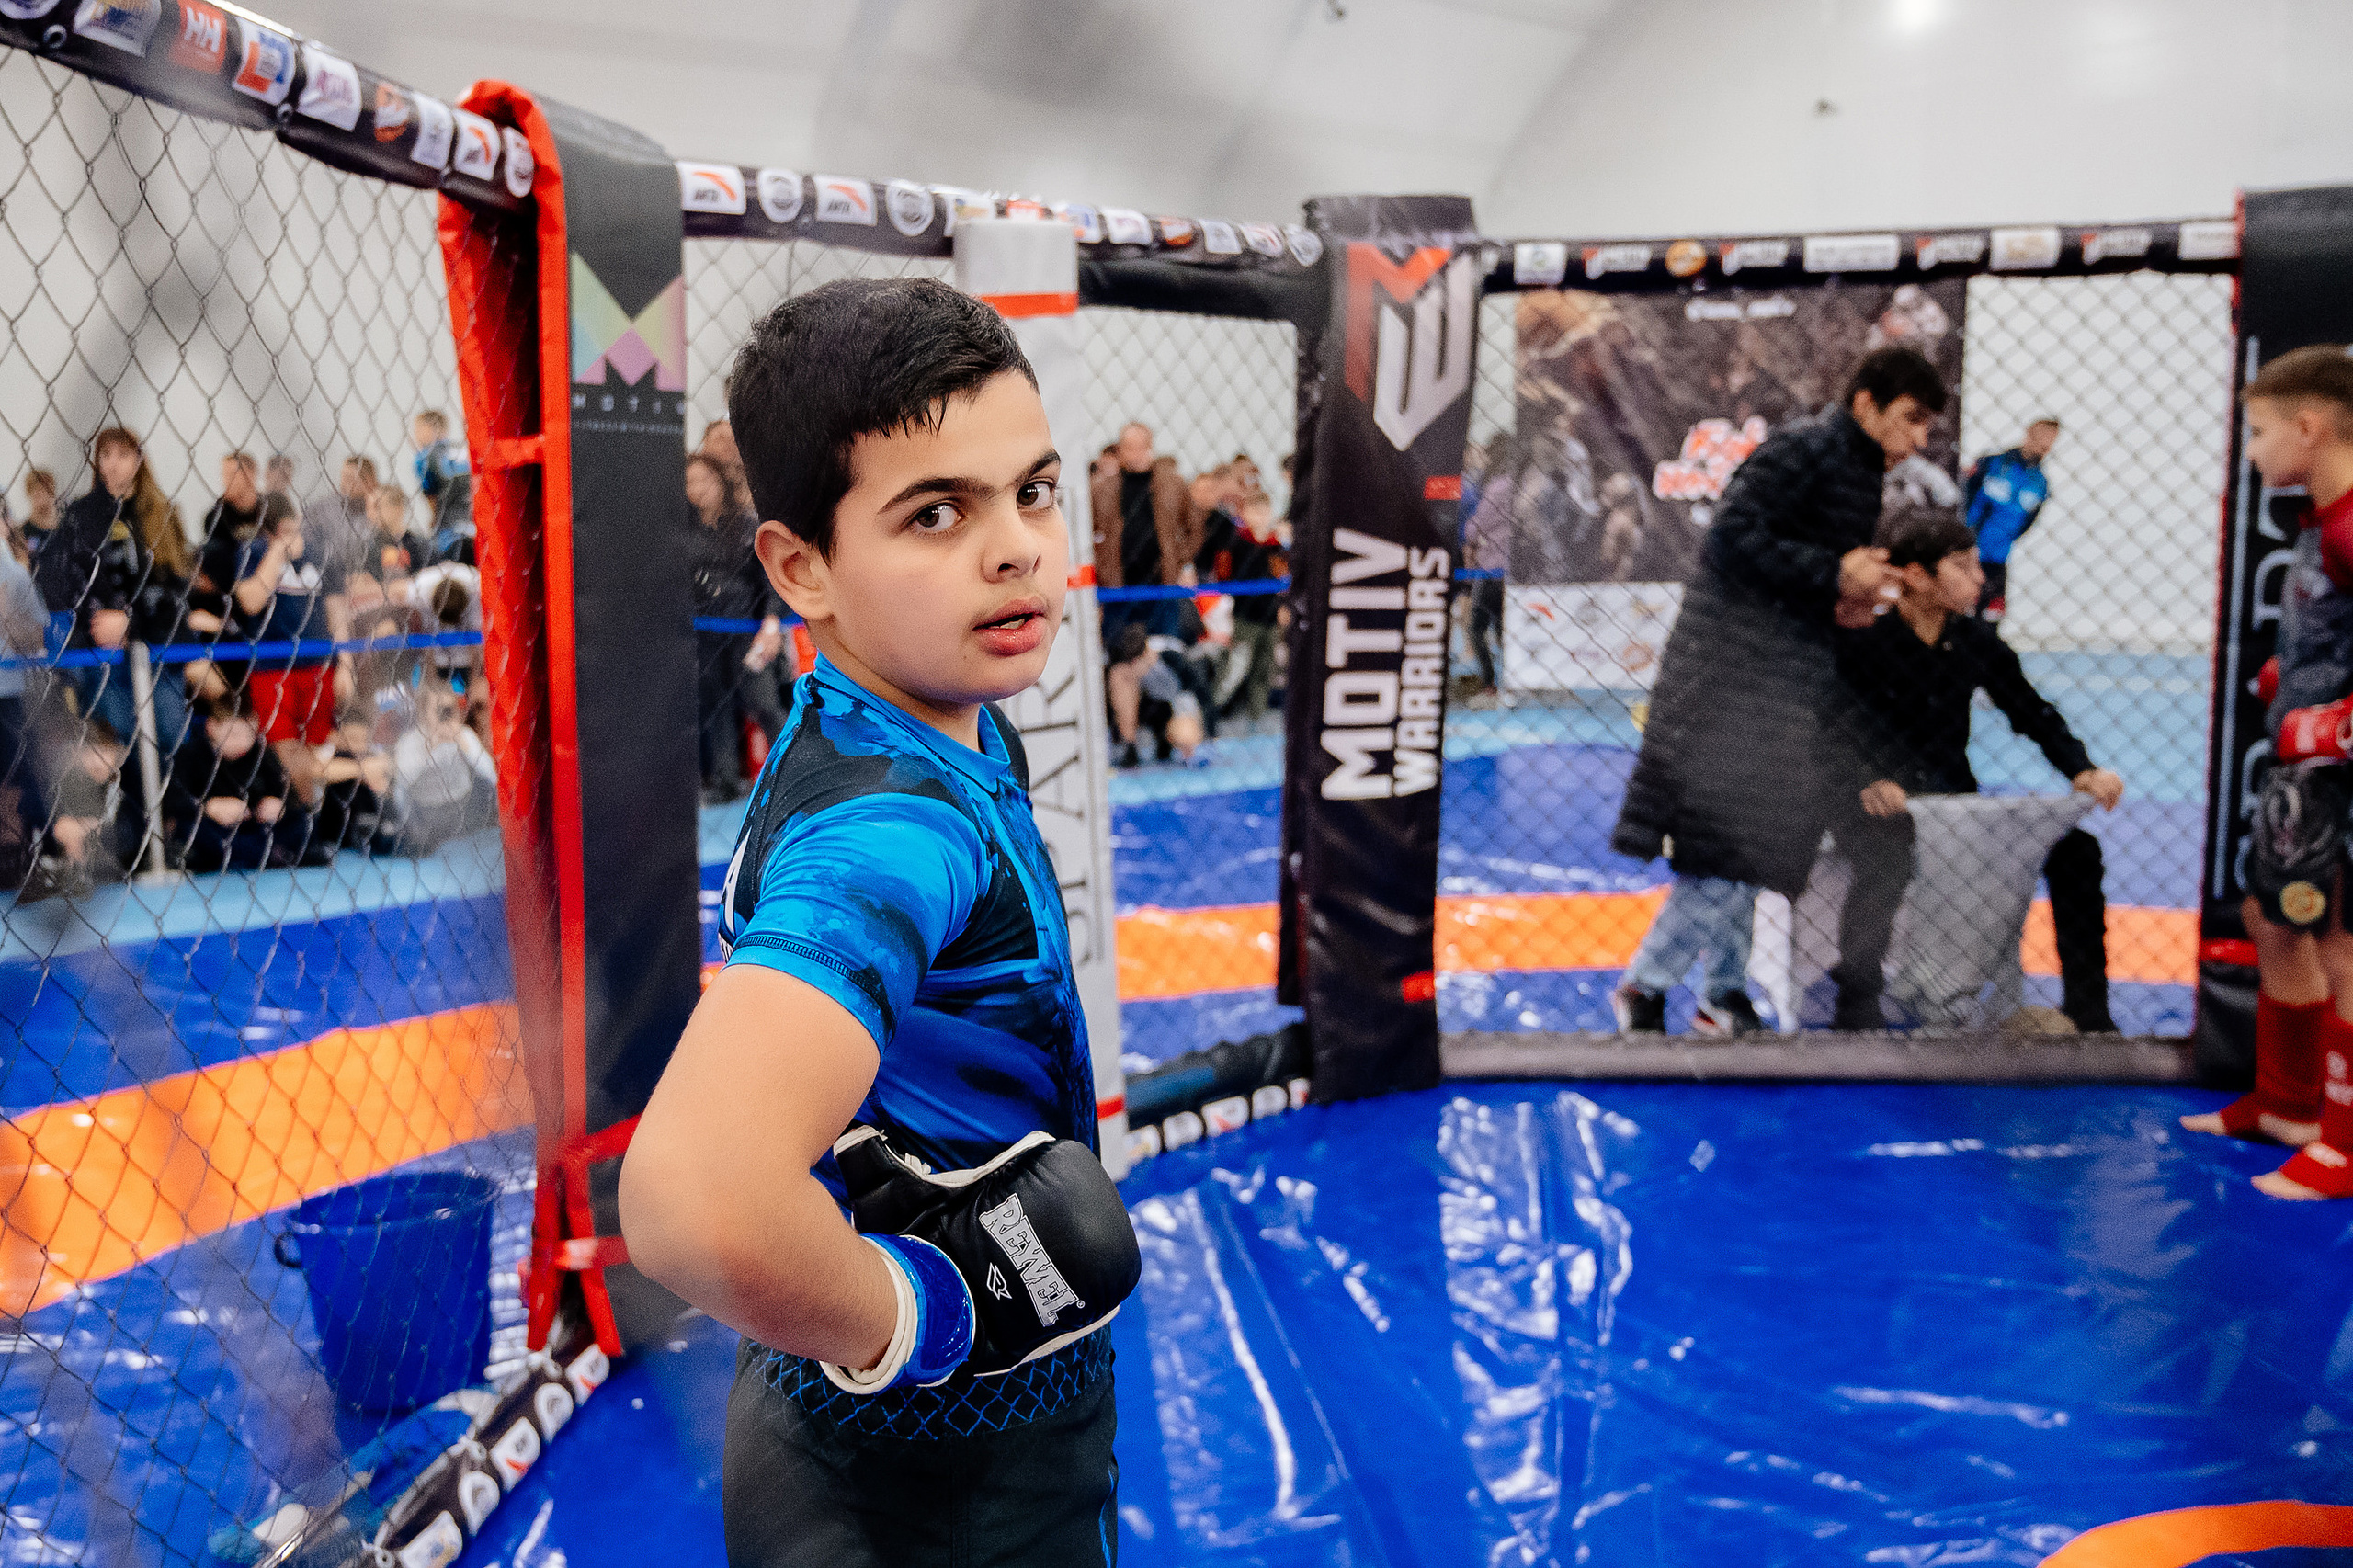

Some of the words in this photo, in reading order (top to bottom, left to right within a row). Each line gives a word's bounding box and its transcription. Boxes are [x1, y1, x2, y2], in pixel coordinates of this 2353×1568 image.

[1320, 527, 1408, 800] MOTIV
[1392, 546, 1451, 798] WARRIORS
[979, 1192, 1079, 1327] REYVEL
